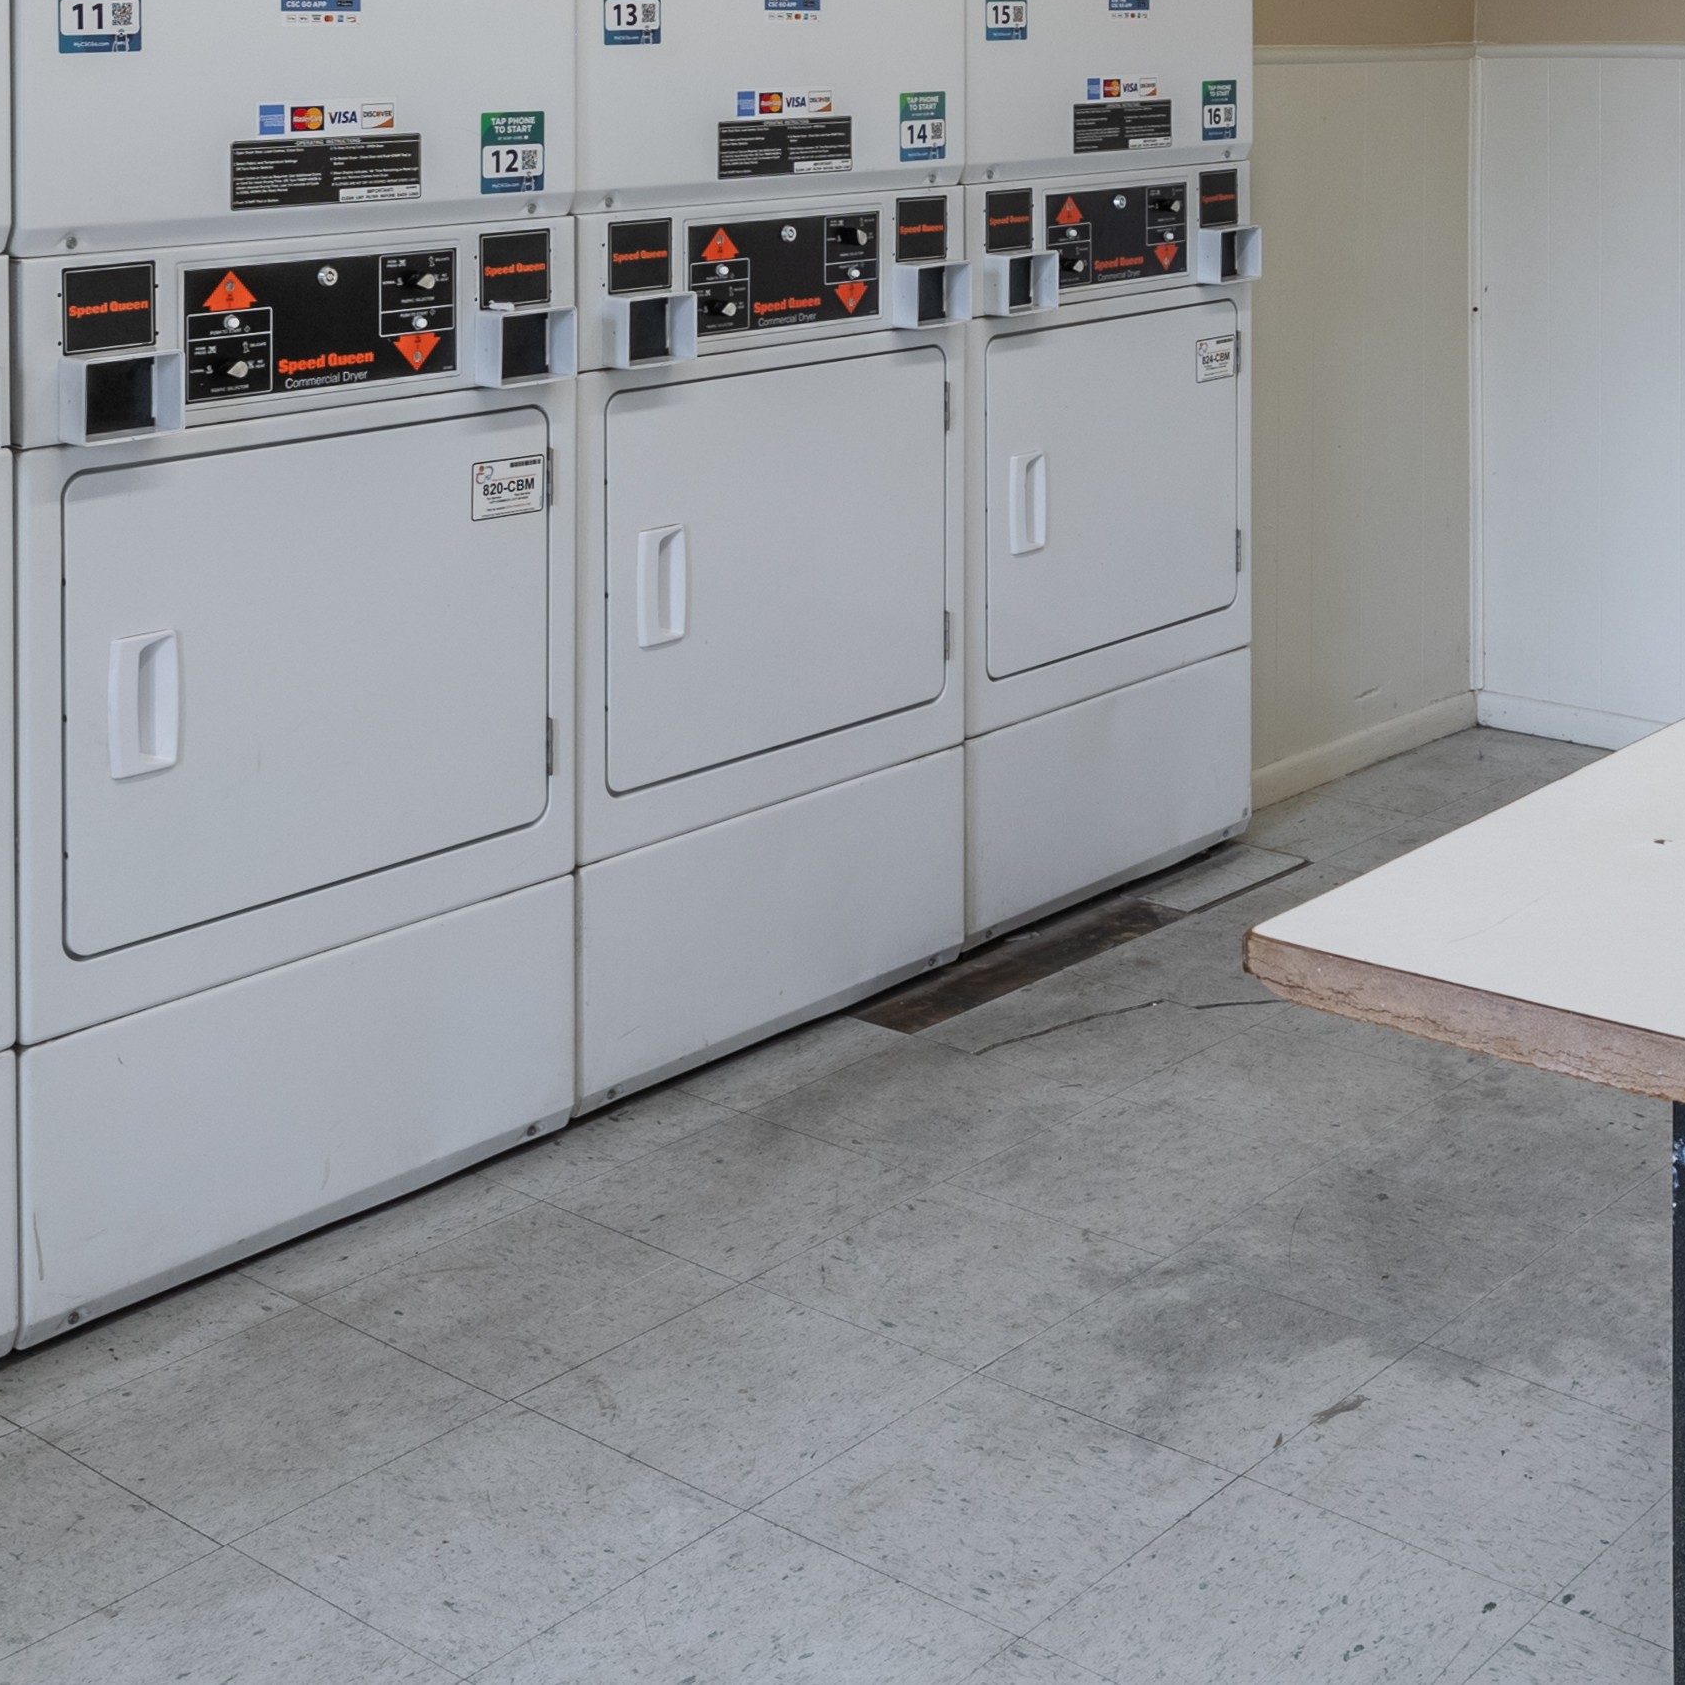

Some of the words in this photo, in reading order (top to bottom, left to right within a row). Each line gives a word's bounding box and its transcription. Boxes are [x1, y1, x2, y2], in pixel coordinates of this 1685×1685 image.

[72, 3, 103, 29] 11
[613, 4, 637, 26] 13
[993, 5, 1010, 24] 15
[1123, 83, 1138, 93] VISA
[786, 97, 806, 107] VISA
[328, 111, 357, 124] VISA
[1208, 108, 1221, 125] 16
[494, 126, 505, 134] TO
[507, 125, 532, 133] START
[907, 124, 927, 144] 14
[491, 149, 519, 173] 12
[612, 251, 639, 263] Speed
[641, 250, 667, 259] Queen
[484, 264, 515, 277] Speed
[516, 263, 546, 273] Queen
[68, 302, 108, 318] Speed
[110, 300, 149, 313] Queen
[753, 298, 786, 315] Speed
[788, 297, 821, 309] Queen
[758, 314, 797, 327] Commercial
[799, 313, 816, 322] Dryer
[278, 354, 325, 375] Speed
[328, 351, 375, 367] Queen
[285, 372, 340, 389] Commercial
[343, 371, 368, 382] Dryer
[483, 477, 534, 496] 820-CBM
